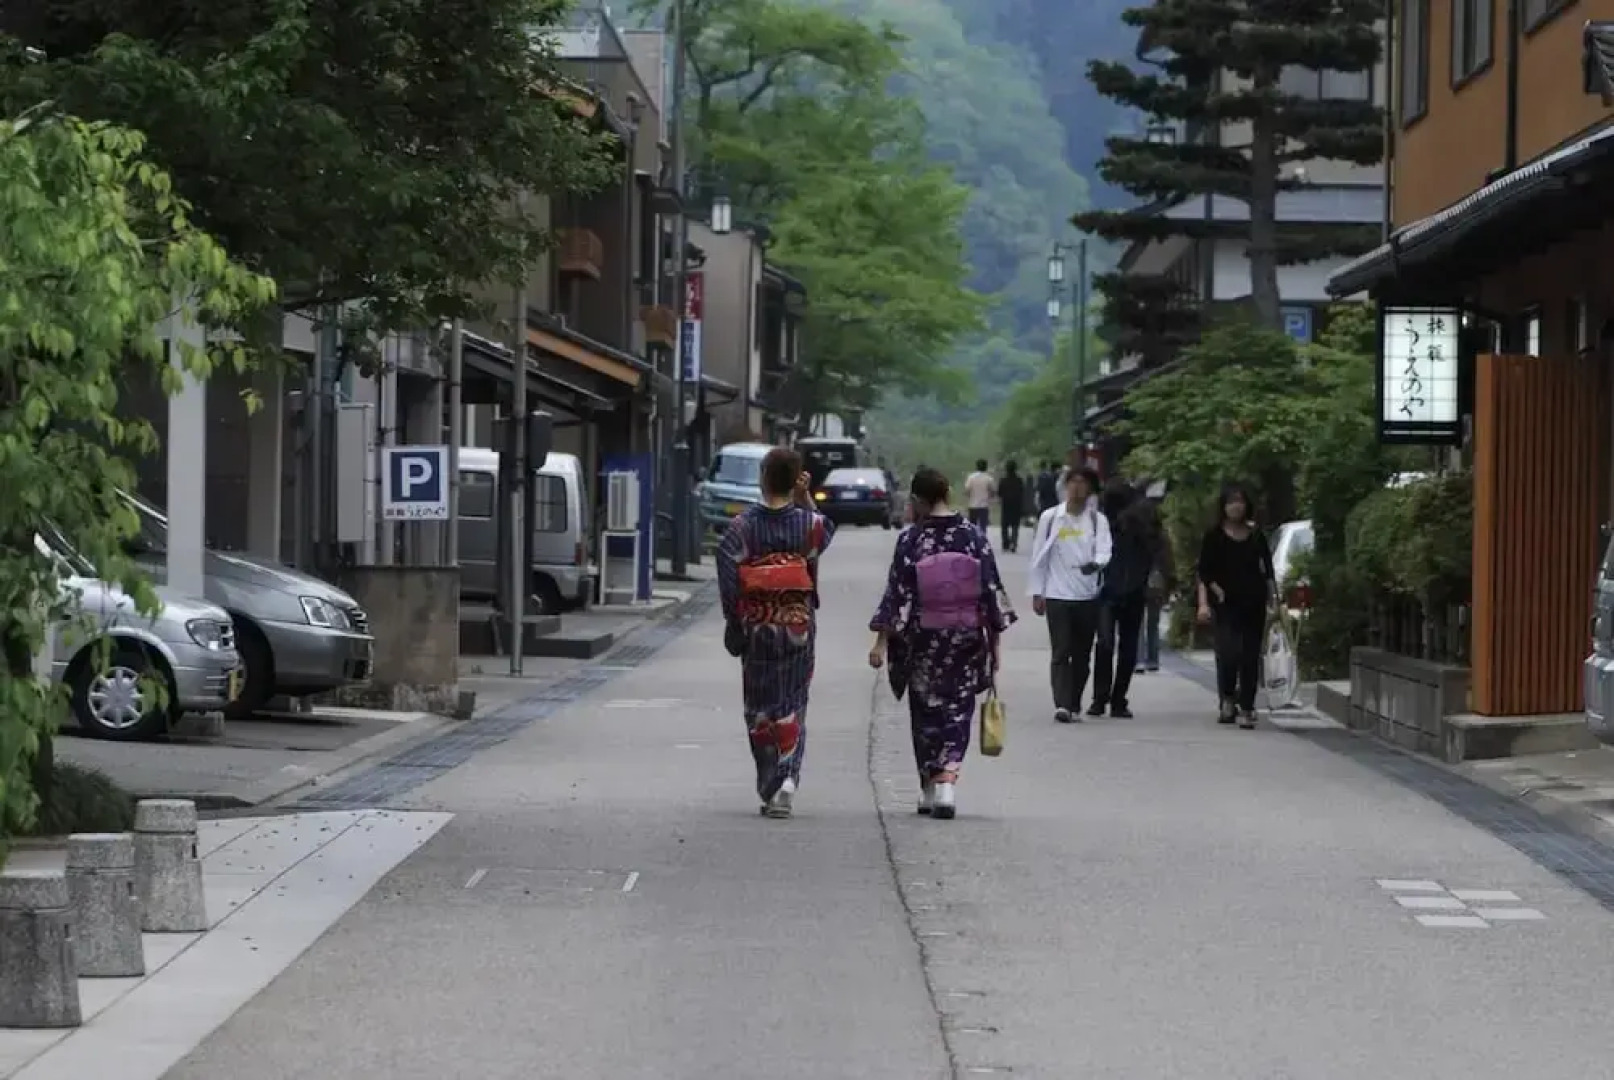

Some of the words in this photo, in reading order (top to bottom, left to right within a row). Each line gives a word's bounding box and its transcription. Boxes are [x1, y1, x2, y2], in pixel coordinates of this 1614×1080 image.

[1398, 318, 1425, 418] うえのや
[401, 457, 433, 498] P
